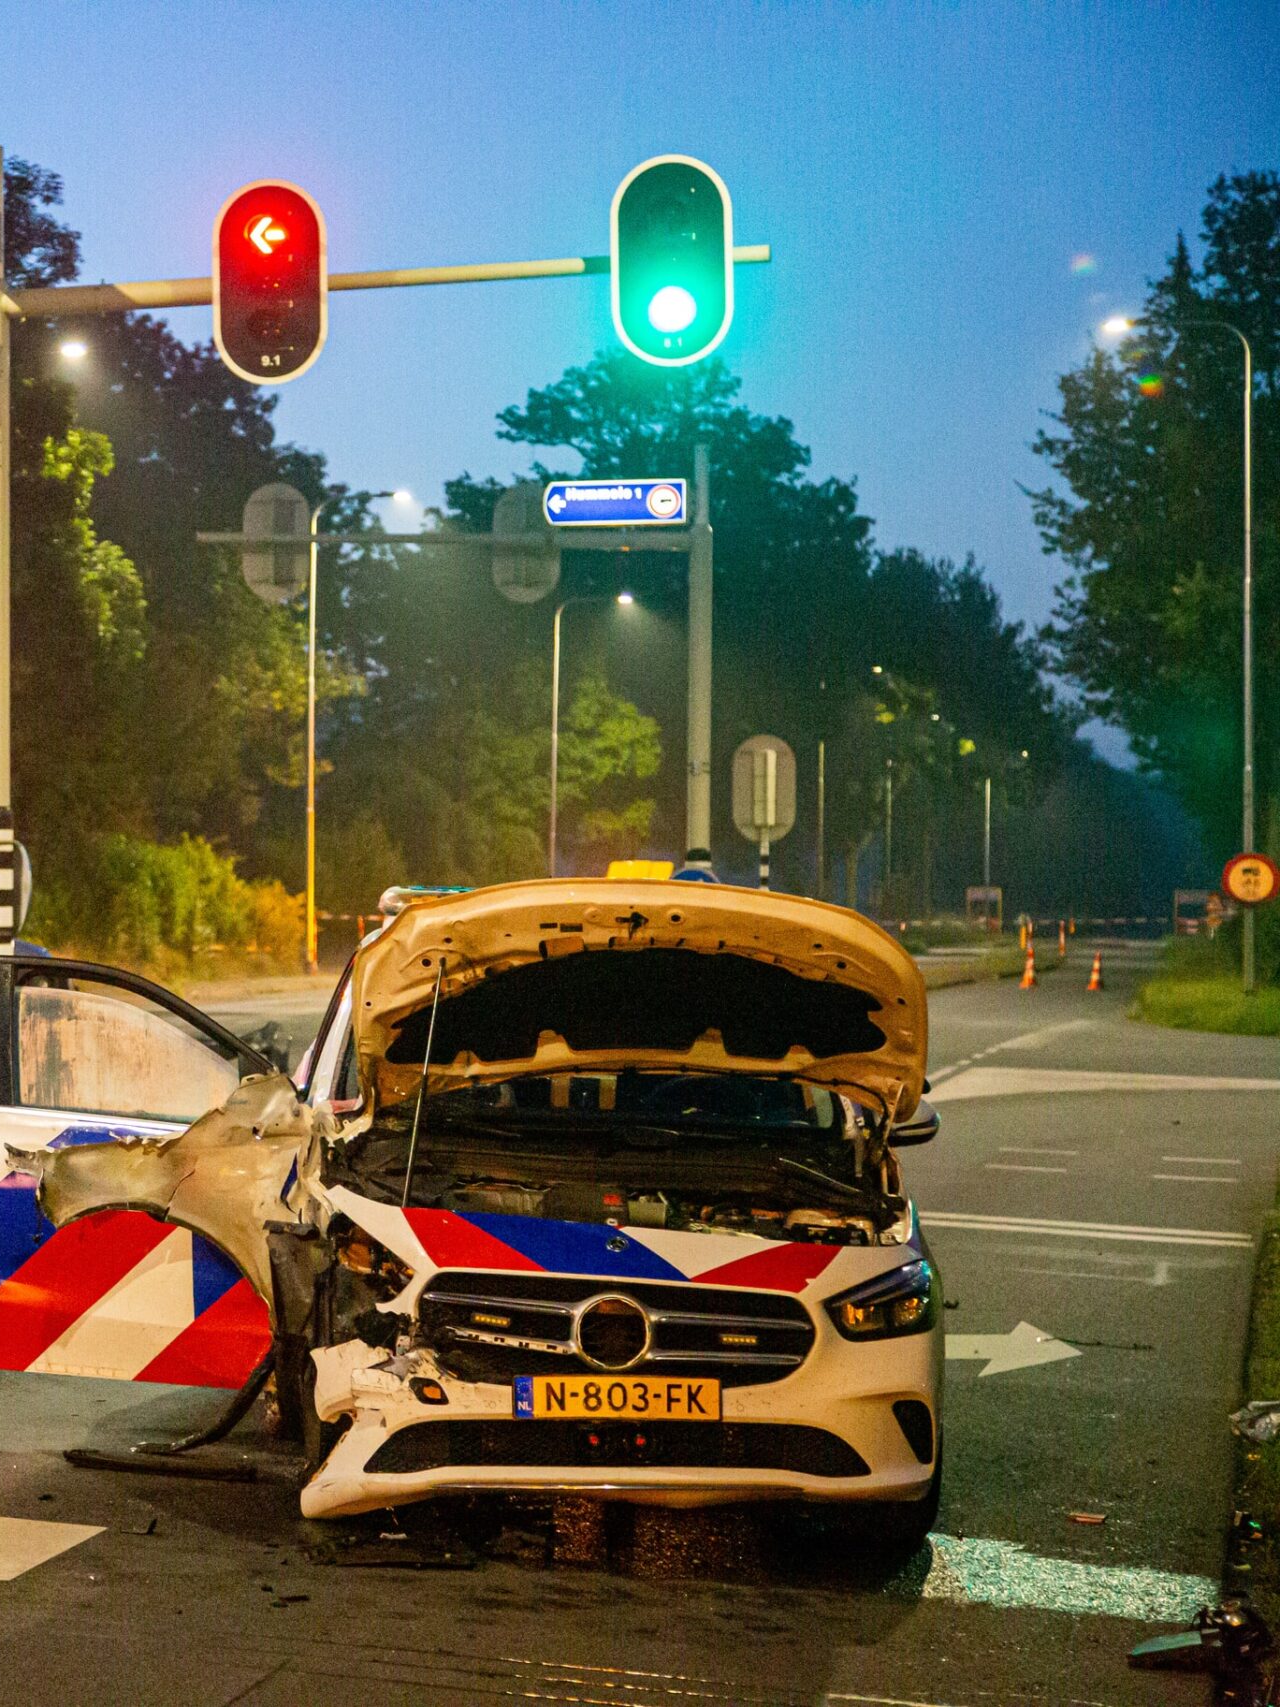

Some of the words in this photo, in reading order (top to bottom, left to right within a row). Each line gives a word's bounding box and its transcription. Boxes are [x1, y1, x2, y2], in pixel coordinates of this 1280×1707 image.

[261, 354, 281, 367] 9.1
[517, 1401, 532, 1411] NL
[545, 1382, 708, 1414] N-803-FK
